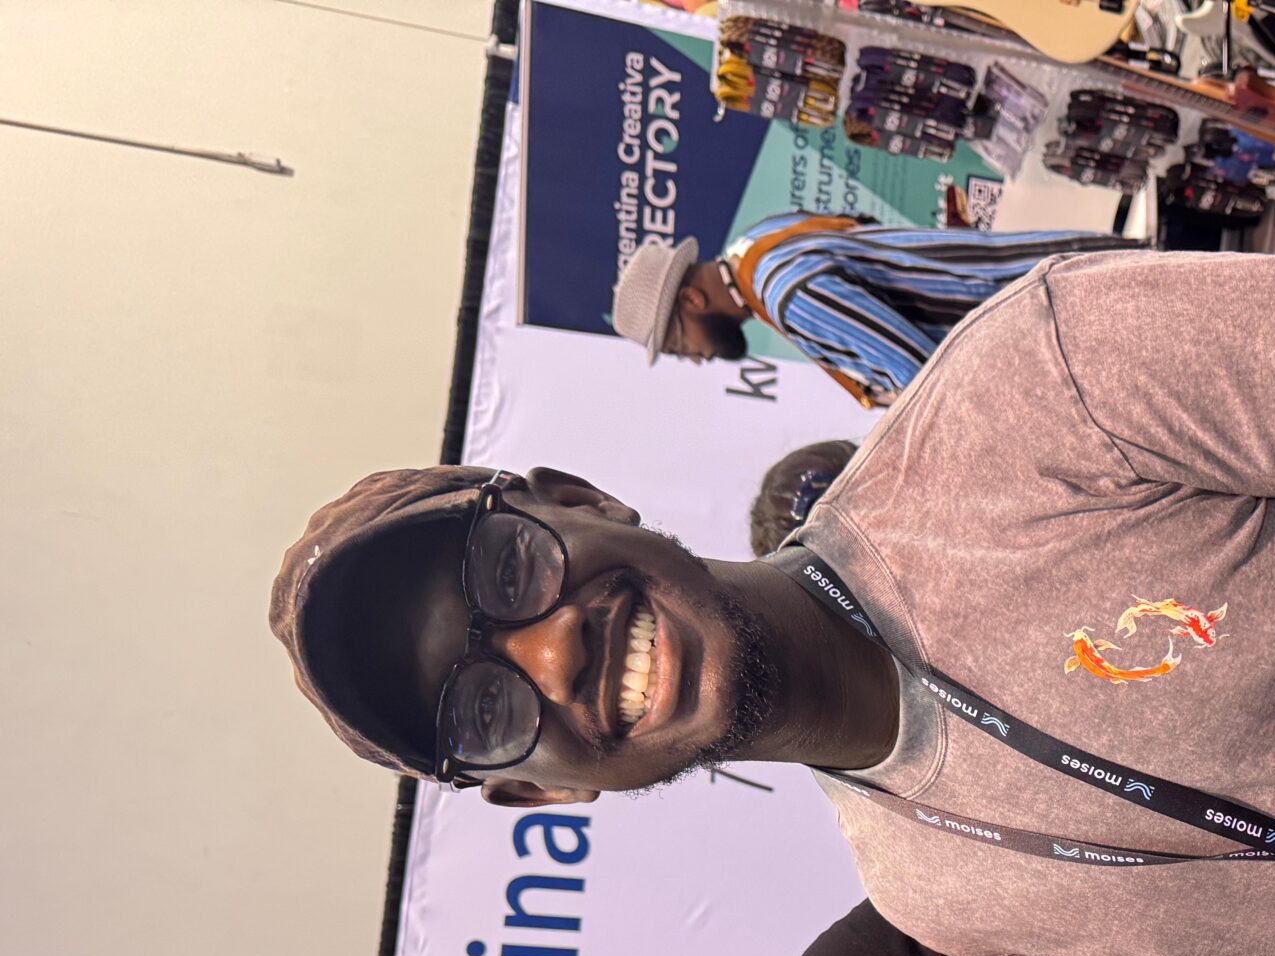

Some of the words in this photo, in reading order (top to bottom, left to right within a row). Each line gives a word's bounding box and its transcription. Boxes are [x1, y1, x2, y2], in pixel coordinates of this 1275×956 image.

[616, 51, 645, 165] Creativa
[801, 564, 855, 612] moises
[920, 677, 979, 719] moises
[1060, 753, 1123, 787] moises
[944, 819, 1002, 841] moises
[1203, 807, 1264, 838] moises
[1083, 850, 1145, 864] moises
